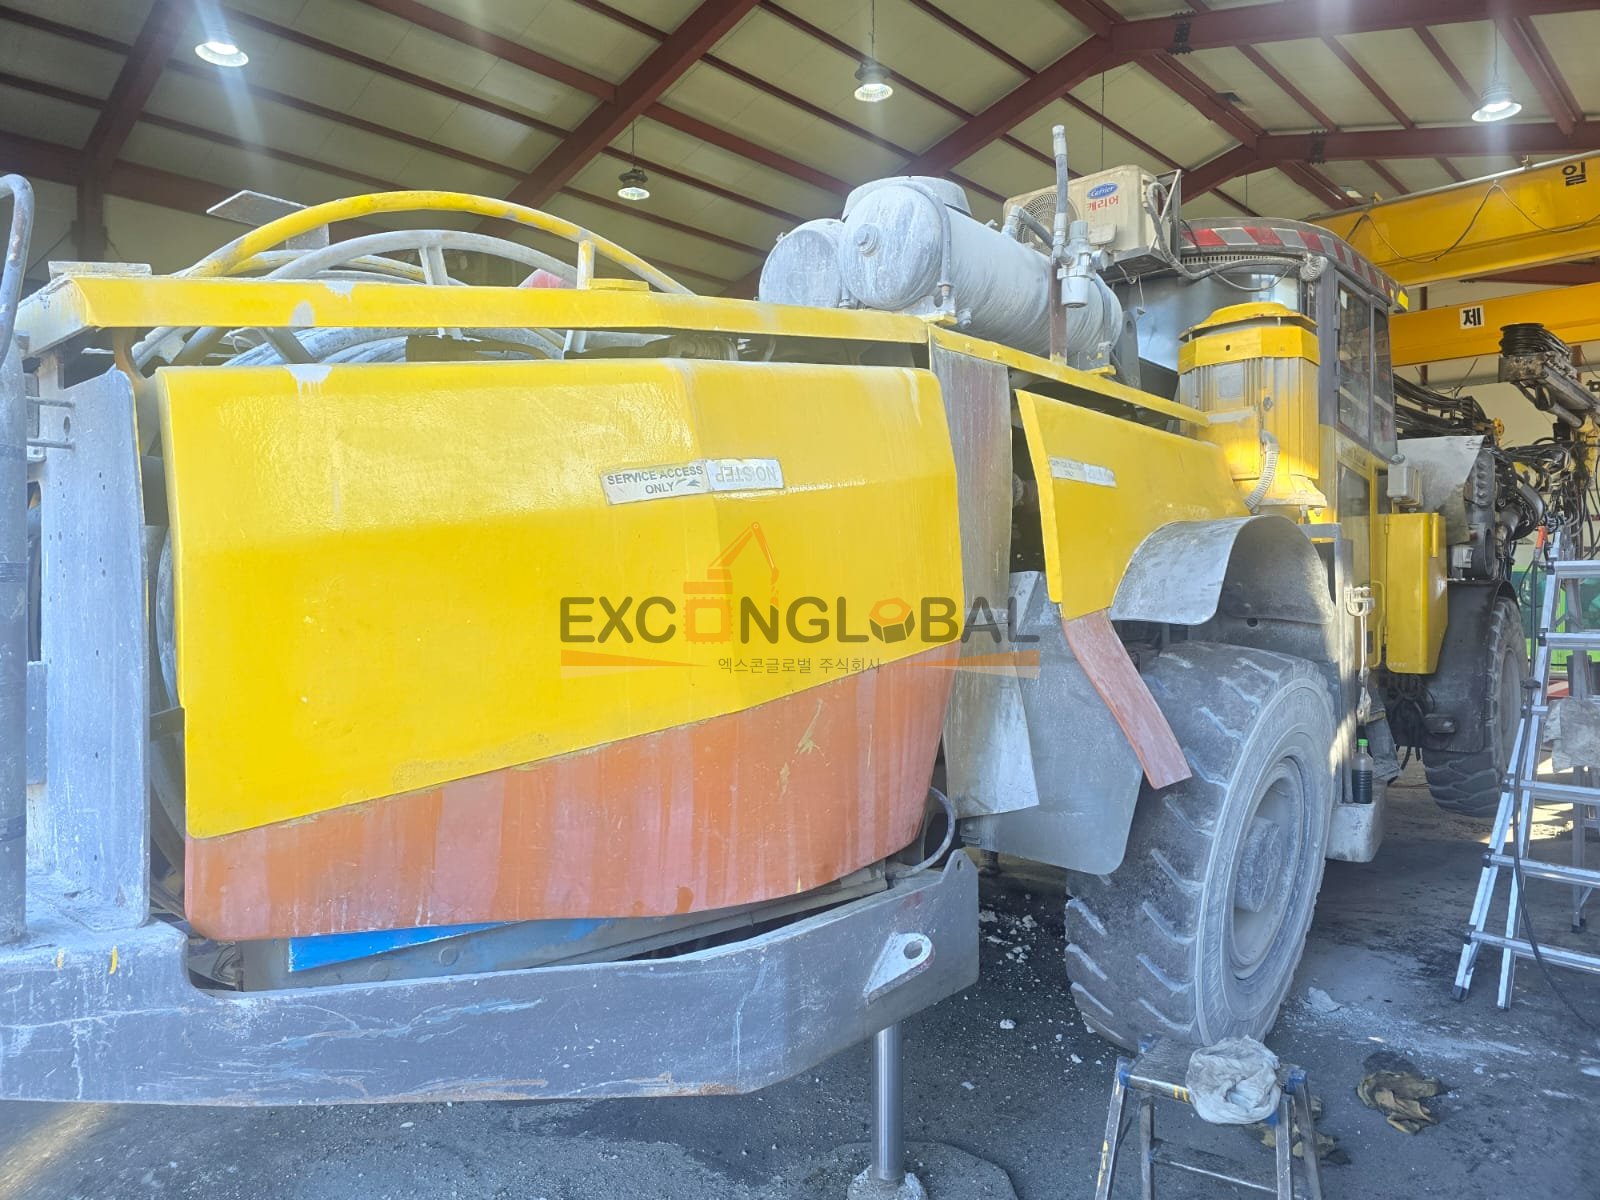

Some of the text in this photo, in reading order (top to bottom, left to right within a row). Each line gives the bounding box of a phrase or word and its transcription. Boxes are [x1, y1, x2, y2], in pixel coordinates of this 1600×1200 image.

[1561, 160, 1587, 187] 일
[1088, 195, 1119, 211] 캐리어
[1462, 307, 1482, 326] 제
[607, 465, 704, 486] SERVICE ACCESS
[714, 466, 778, 484] NO STEP
[645, 481, 675, 495] ONLY
